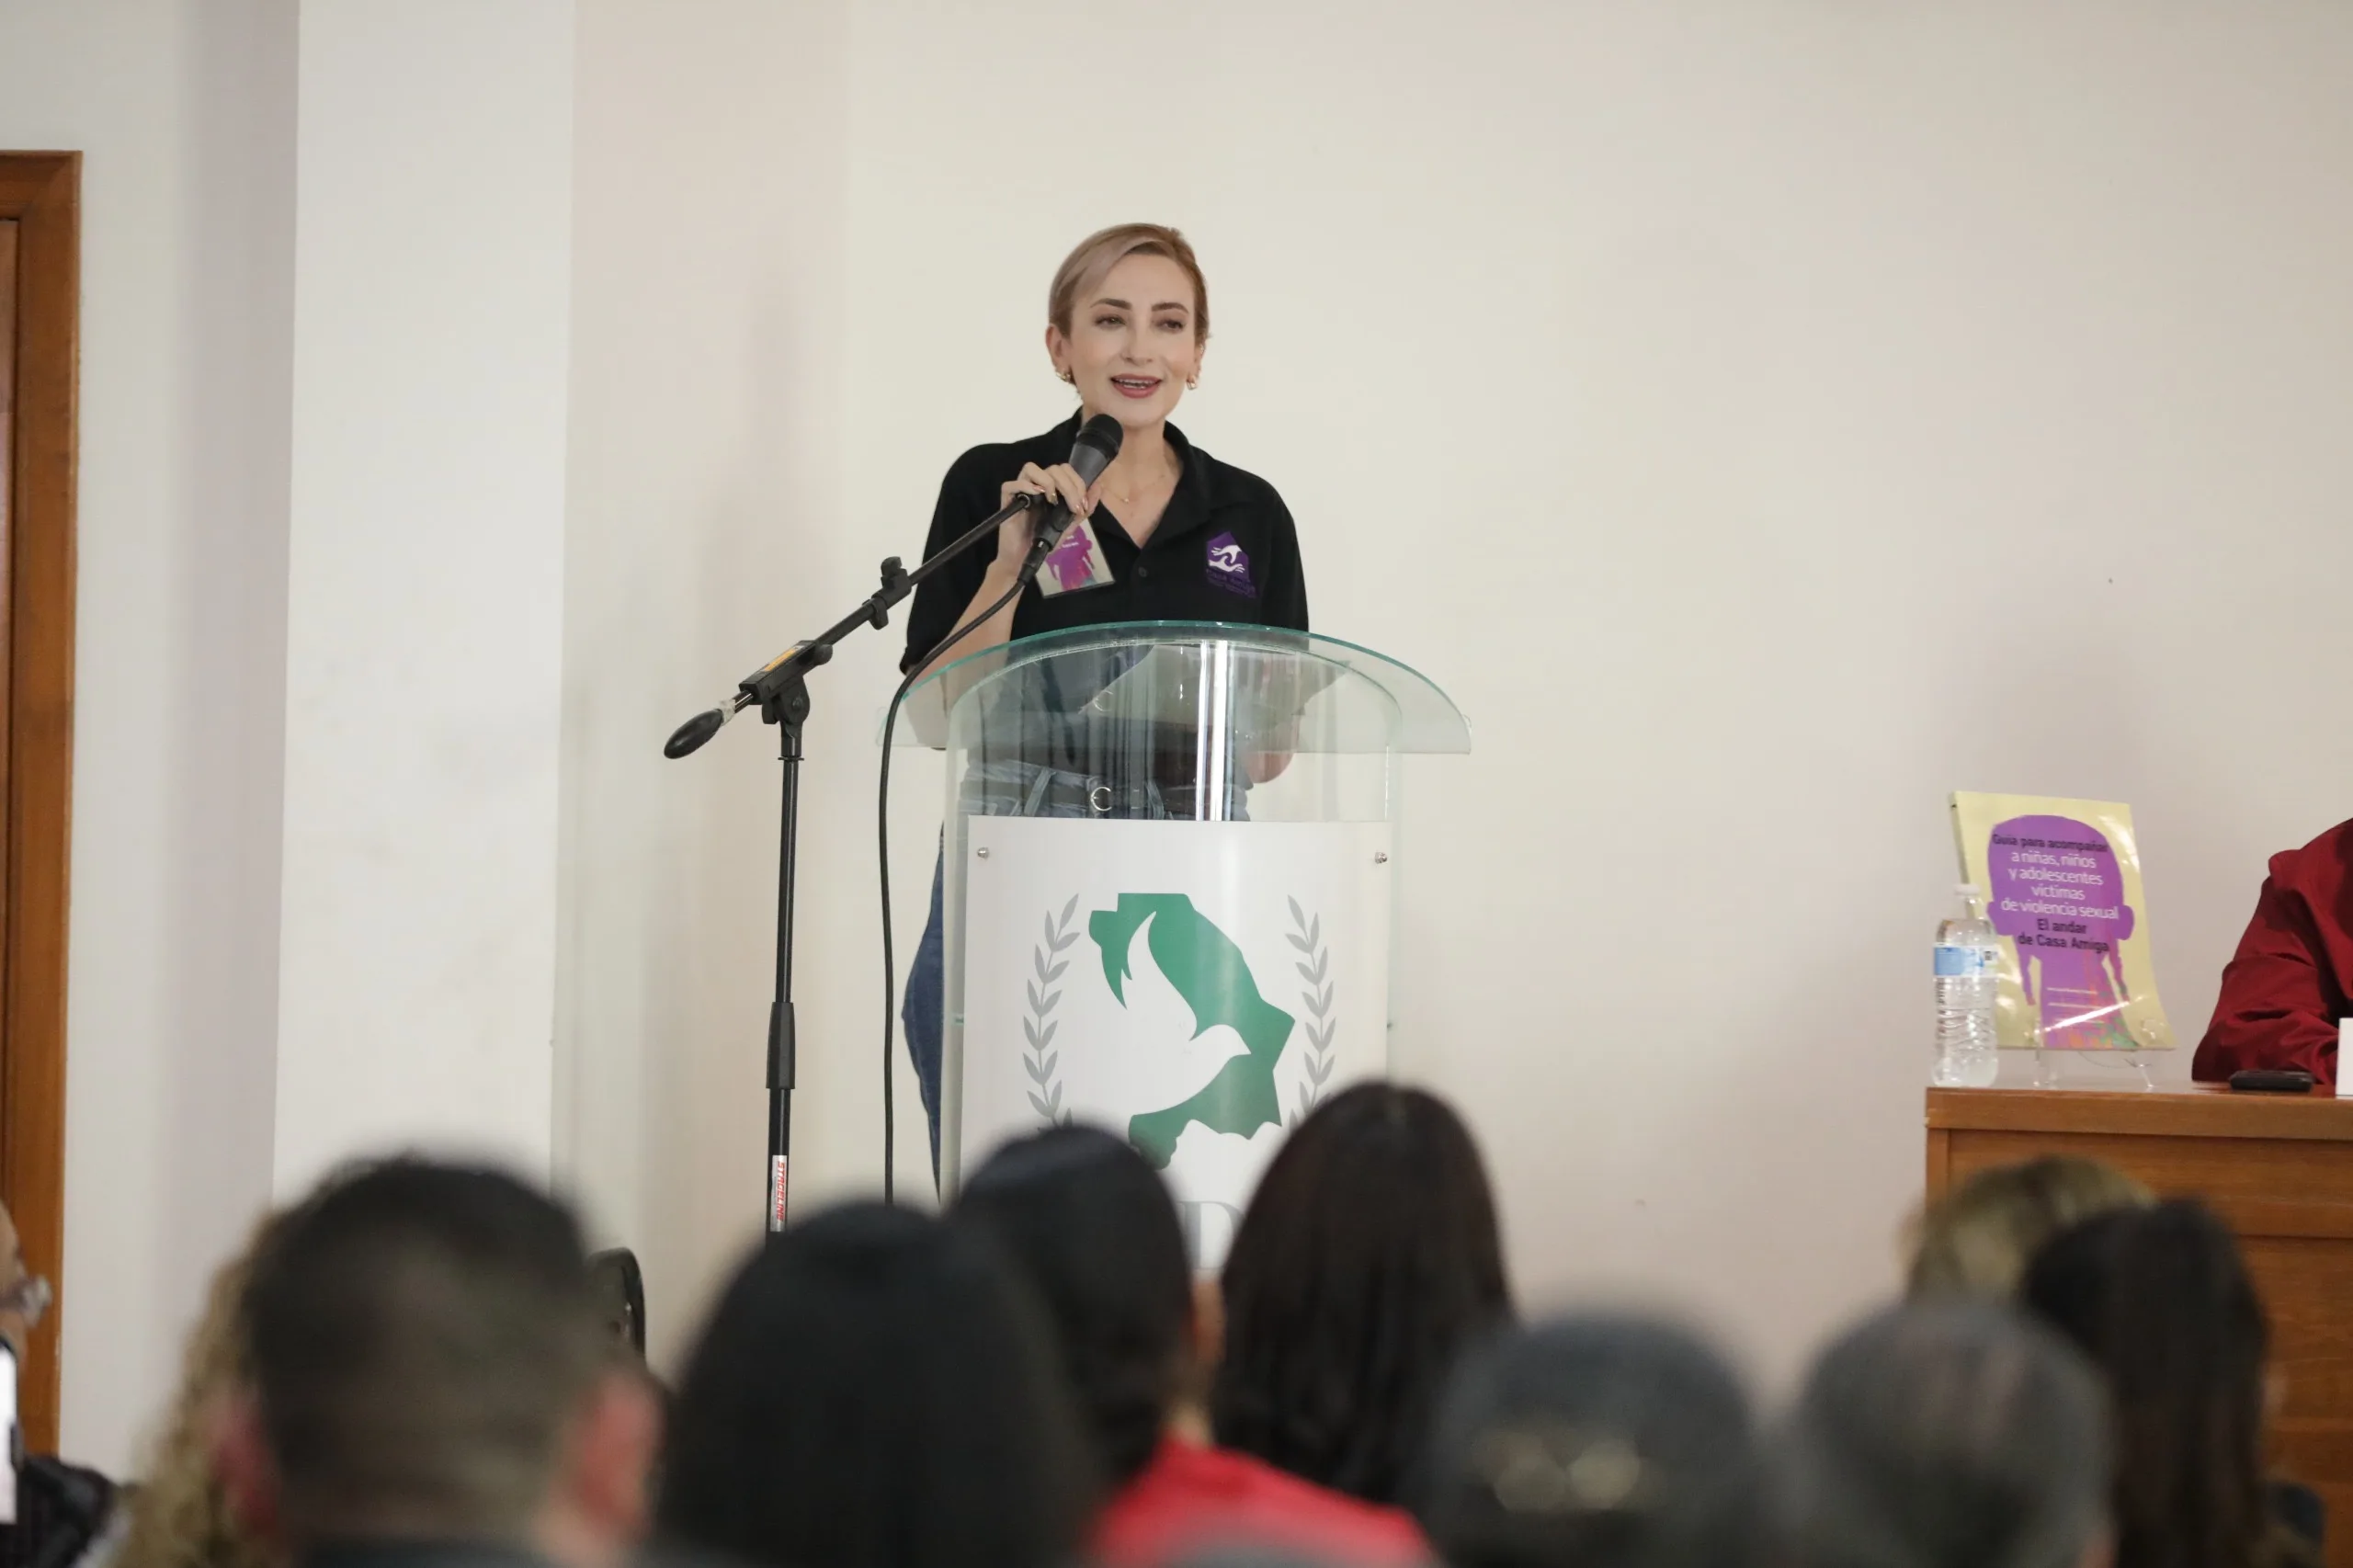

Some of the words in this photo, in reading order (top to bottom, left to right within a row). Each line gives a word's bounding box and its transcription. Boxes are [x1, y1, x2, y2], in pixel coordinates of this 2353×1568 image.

[2021, 837, 2045, 848] para
[2011, 852, 2019, 862] a
[2021, 849, 2061, 867] niñas,
[2061, 852, 2097, 869] niños
[2007, 868, 2018, 881] y
[2019, 866, 2103, 885] adolescentes
[2001, 897, 2018, 912] de
[2018, 899, 2077, 916] violencia
[2079, 905, 2119, 920] sexual
[2037, 918, 2049, 931] El
[2052, 920, 2086, 934] andar
[2018, 931, 2033, 946] de
[2037, 933, 2067, 949] Casa
[2071, 936, 2109, 954] Amiga
